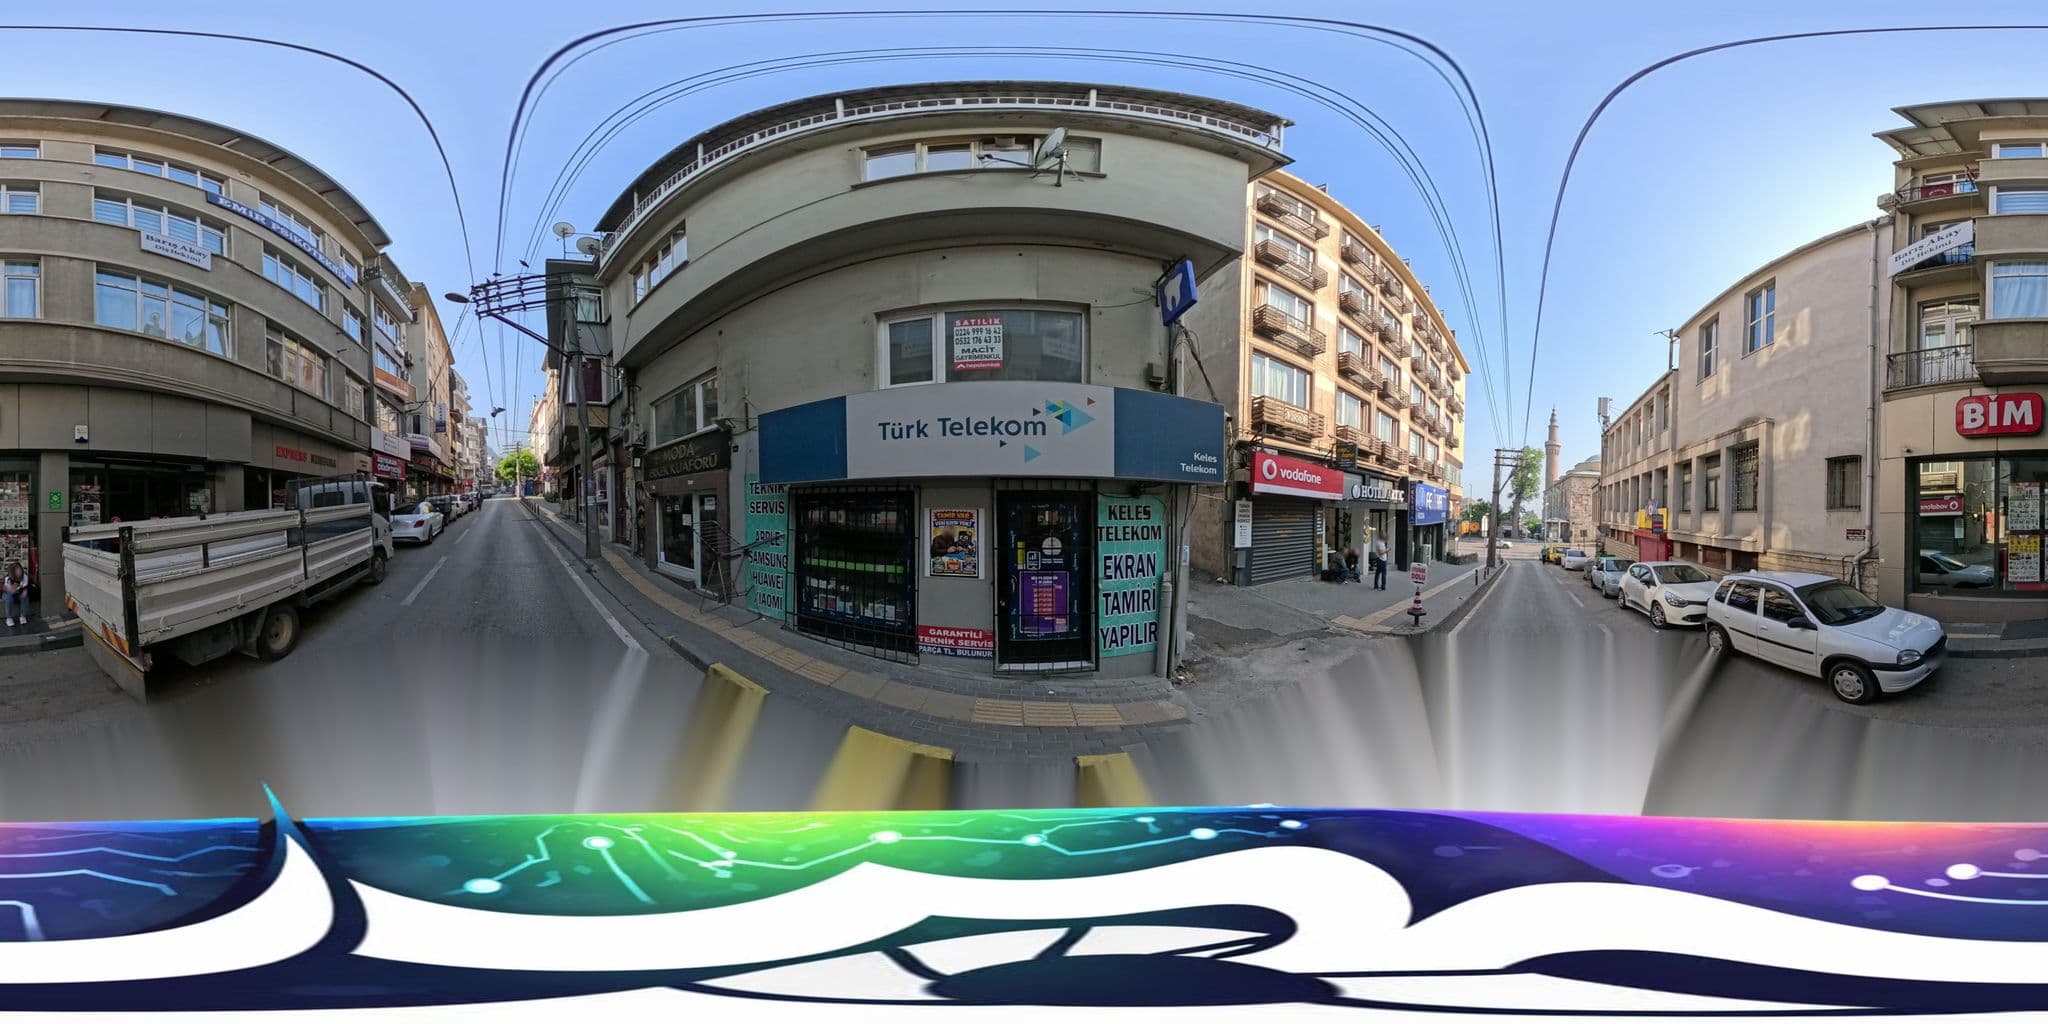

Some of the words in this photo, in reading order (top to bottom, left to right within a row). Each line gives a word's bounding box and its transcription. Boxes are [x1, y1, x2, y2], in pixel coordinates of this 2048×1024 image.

[1926, 228, 1962, 247] Akay
[179, 243, 208, 260] Akay
[955, 318, 1001, 326] SATILIK
[961, 345, 995, 354] MACİT
[1963, 394, 2034, 429] BİM
[878, 419, 929, 440] Türk
[937, 416, 1047, 437] Telekom
[663, 441, 695, 460] MODA
[1193, 452, 1218, 463] Keles
[1180, 463, 1217, 475] Telekom
[1280, 468, 1323, 485] vodafone
[1108, 504, 1151, 521] KELES
[1098, 525, 1162, 542] TELEKOM
[749, 551, 788, 569] SAMSUNG
[1103, 553, 1156, 580] EKRAN
[1102, 583, 1156, 616] TAMİRİ
[918, 635, 955, 646] TEKNİK
[958, 639, 994, 648] SERVİS
[928, 628, 983, 639] GARANTİLİ
[1100, 620, 1158, 650] YAPILIR
[918, 645, 942, 654] PARÇA
[956, 648, 993, 657] BULUNUR
